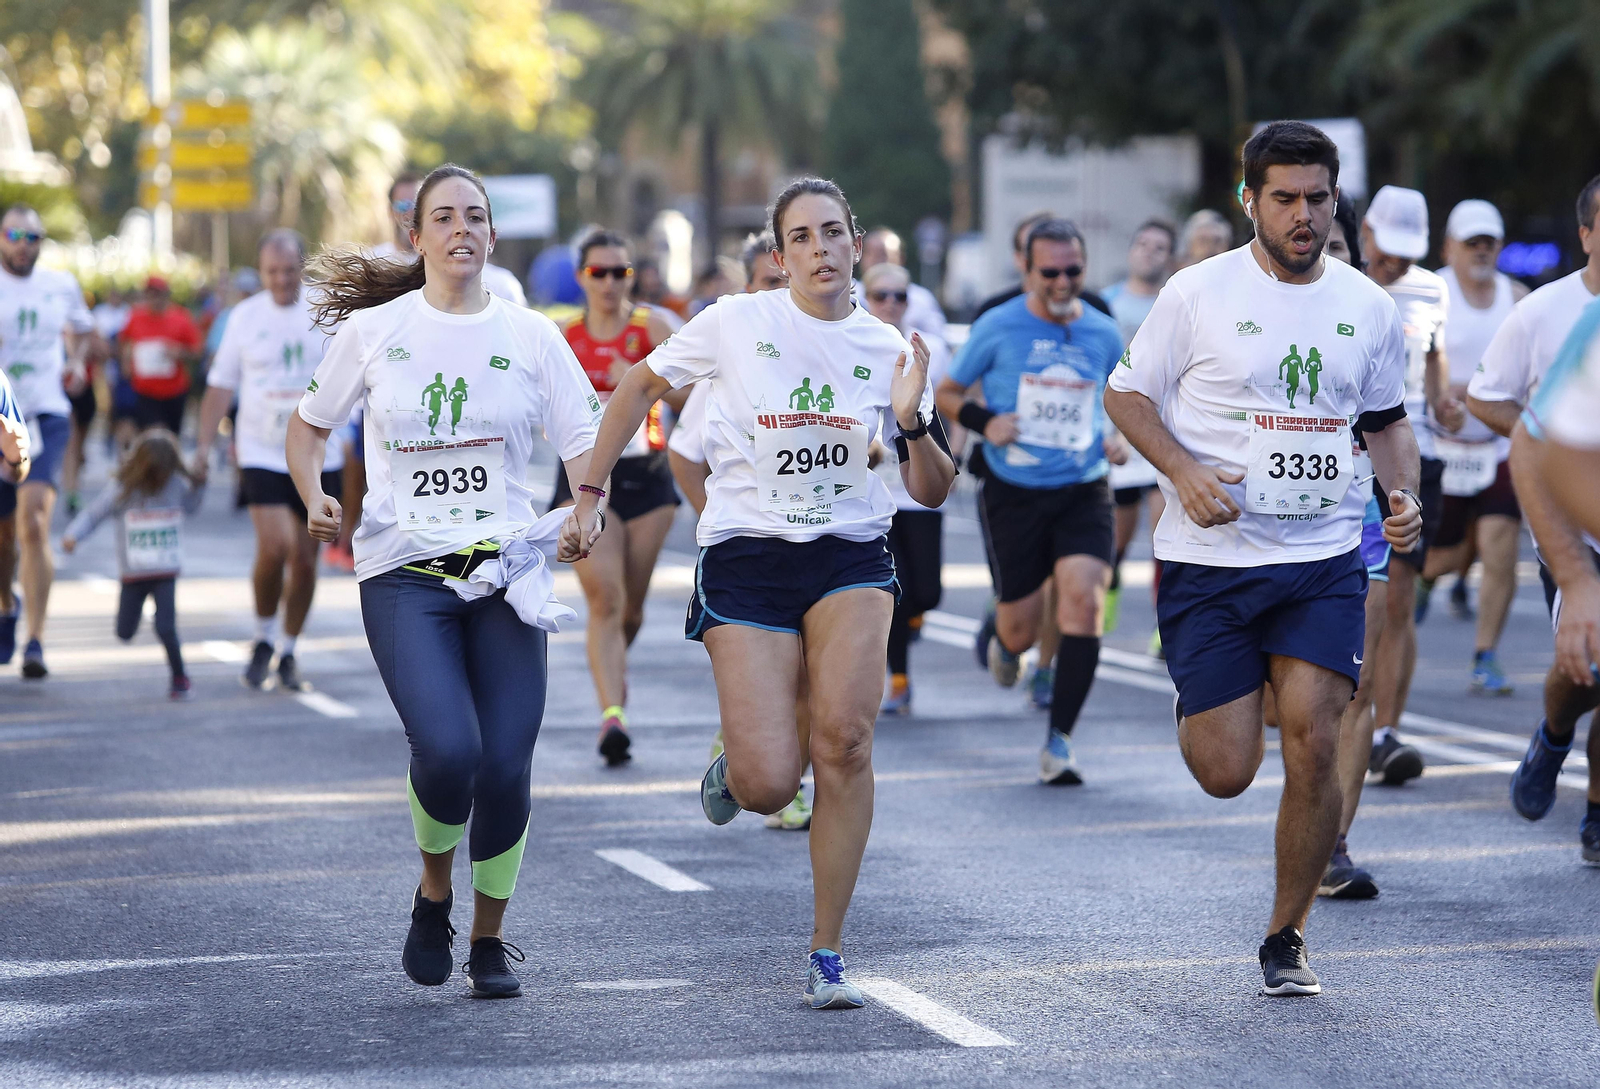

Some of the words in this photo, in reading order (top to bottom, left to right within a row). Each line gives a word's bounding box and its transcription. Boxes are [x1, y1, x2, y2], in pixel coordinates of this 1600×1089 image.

[758, 414, 778, 429] 41
[779, 413, 824, 422] CARRERA
[780, 420, 806, 429] CIUDAD
[1254, 415, 1274, 430] 41
[1276, 416, 1318, 426] CARRERA
[1276, 424, 1304, 432] CIUDAD
[776, 443, 849, 476] 2940
[1268, 452, 1339, 481] 3338
[412, 465, 488, 497] 2939
[786, 513, 832, 525] Unicaja
